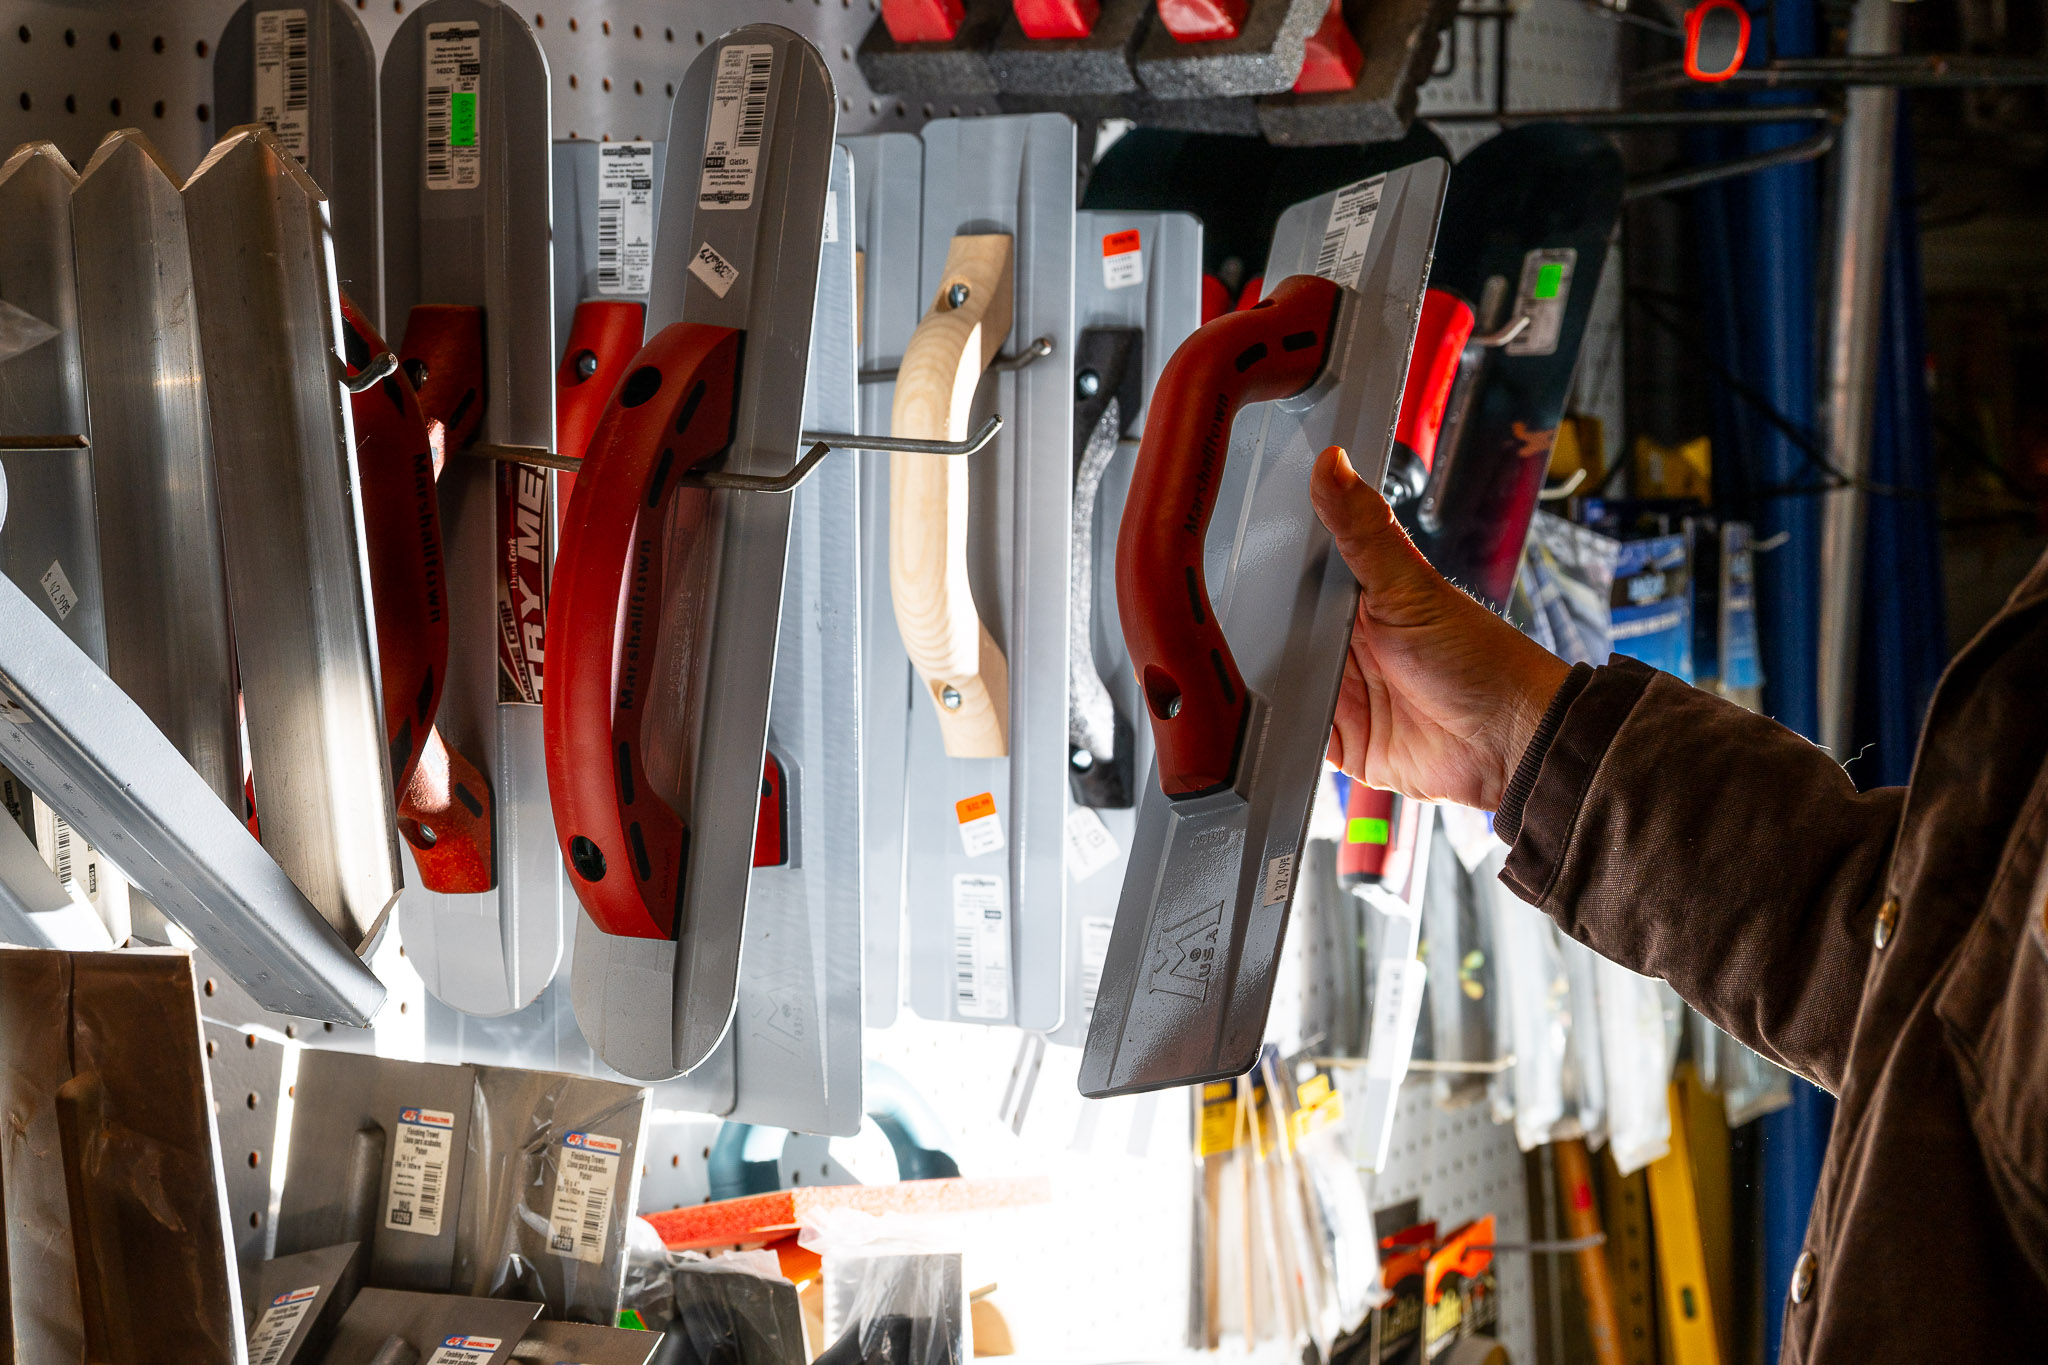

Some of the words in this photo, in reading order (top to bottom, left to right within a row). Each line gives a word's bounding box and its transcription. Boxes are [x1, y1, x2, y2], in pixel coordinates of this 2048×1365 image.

[518, 462, 546, 564] ME
[1184, 393, 1229, 536] Marshalltown
[414, 453, 440, 624] Marshalltown
[620, 540, 651, 710] Marshalltown
[1274, 862, 1290, 894] 32.99
[1200, 928, 1219, 978] USA
